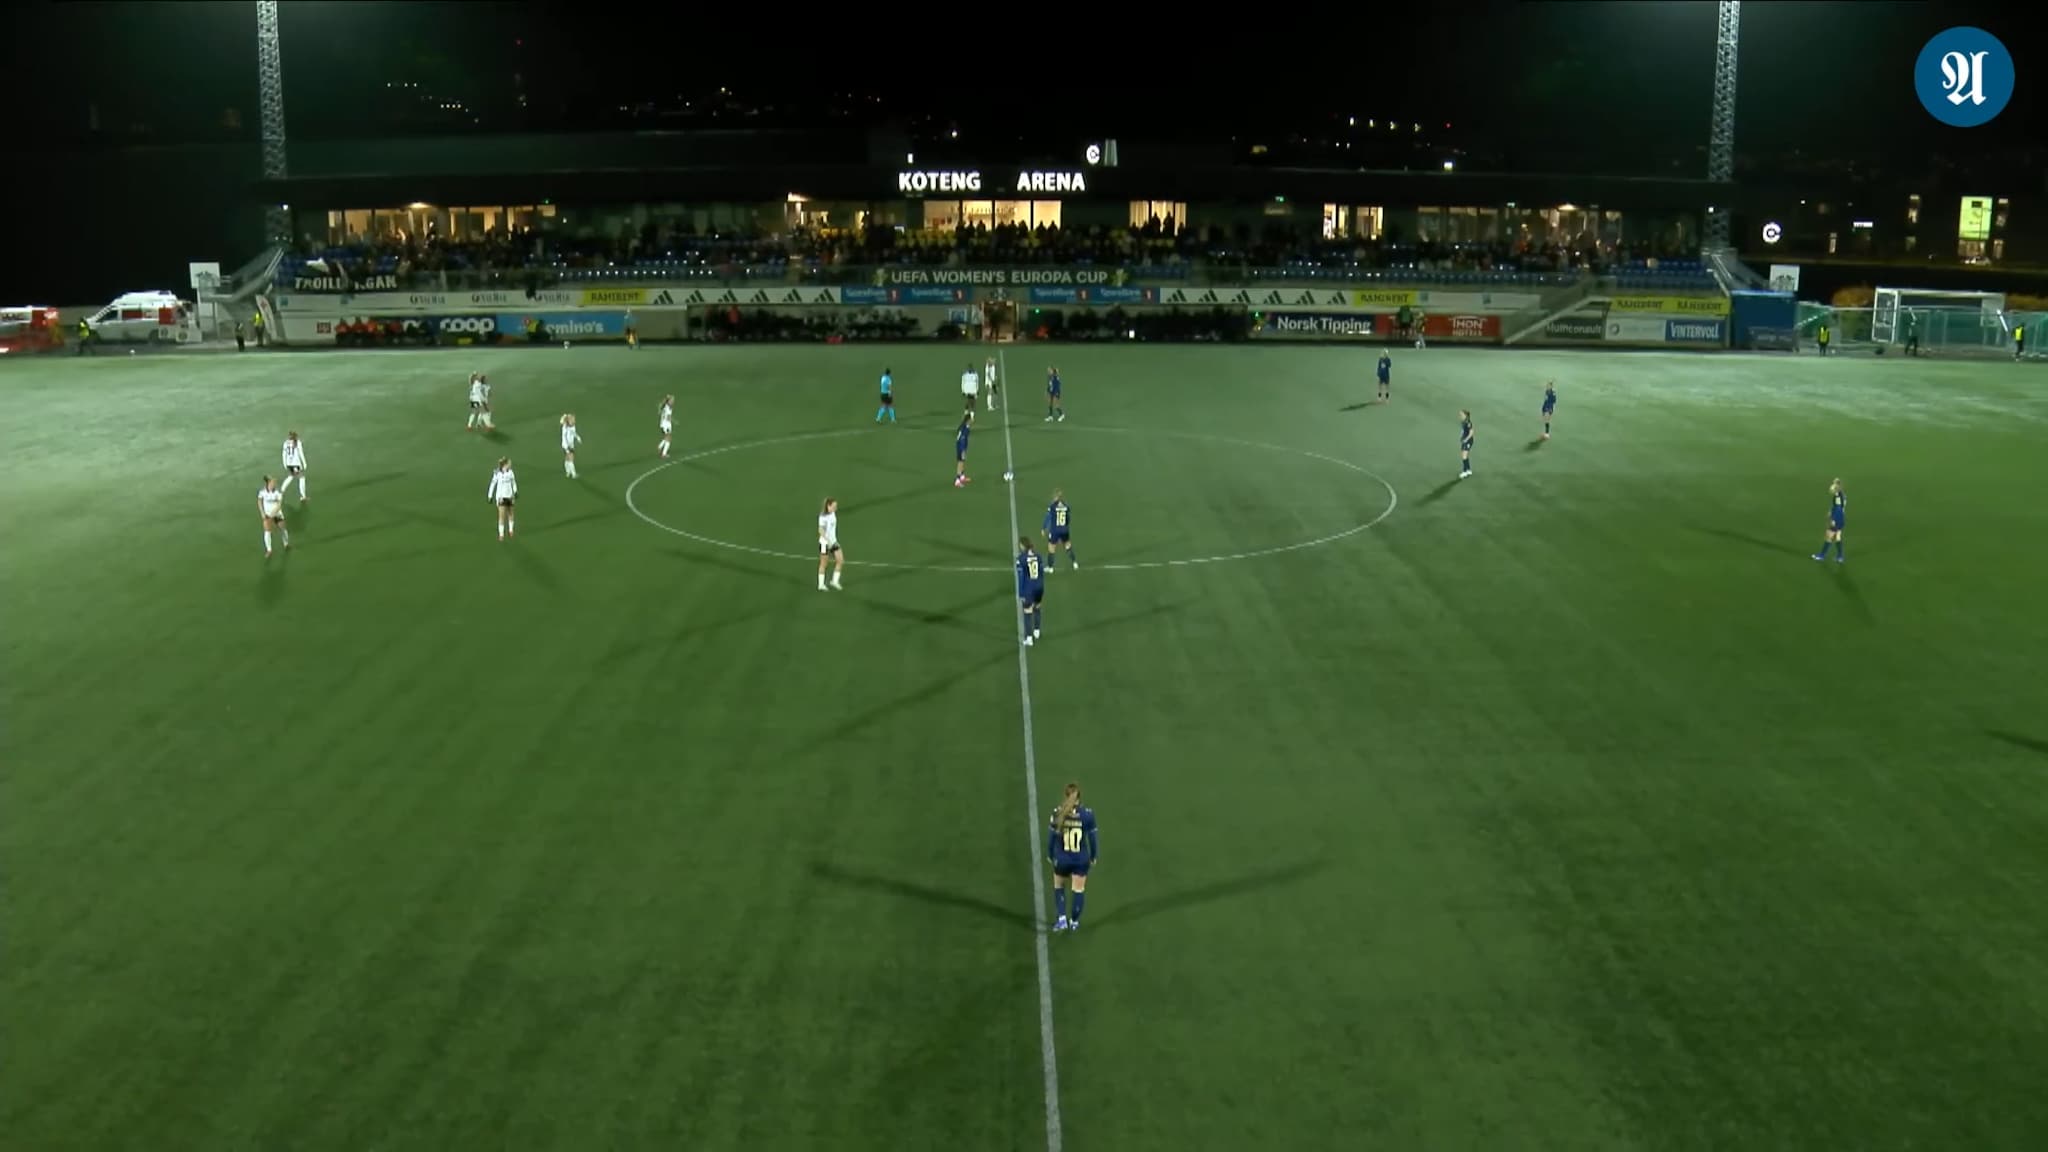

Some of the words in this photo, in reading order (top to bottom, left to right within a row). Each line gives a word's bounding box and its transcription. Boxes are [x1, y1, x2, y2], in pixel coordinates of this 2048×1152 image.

[898, 171, 982, 191] KOTENG
[1016, 171, 1086, 191] ARENA
[891, 270, 929, 284] UEFA
[932, 270, 1006, 284] WOMEN'S
[1011, 270, 1073, 284] EUROPA
[1076, 270, 1109, 284] CUP
[1276, 316, 1318, 331] Norsk
[1320, 317, 1372, 335] Tipping
[1063, 827, 1083, 853] 10
